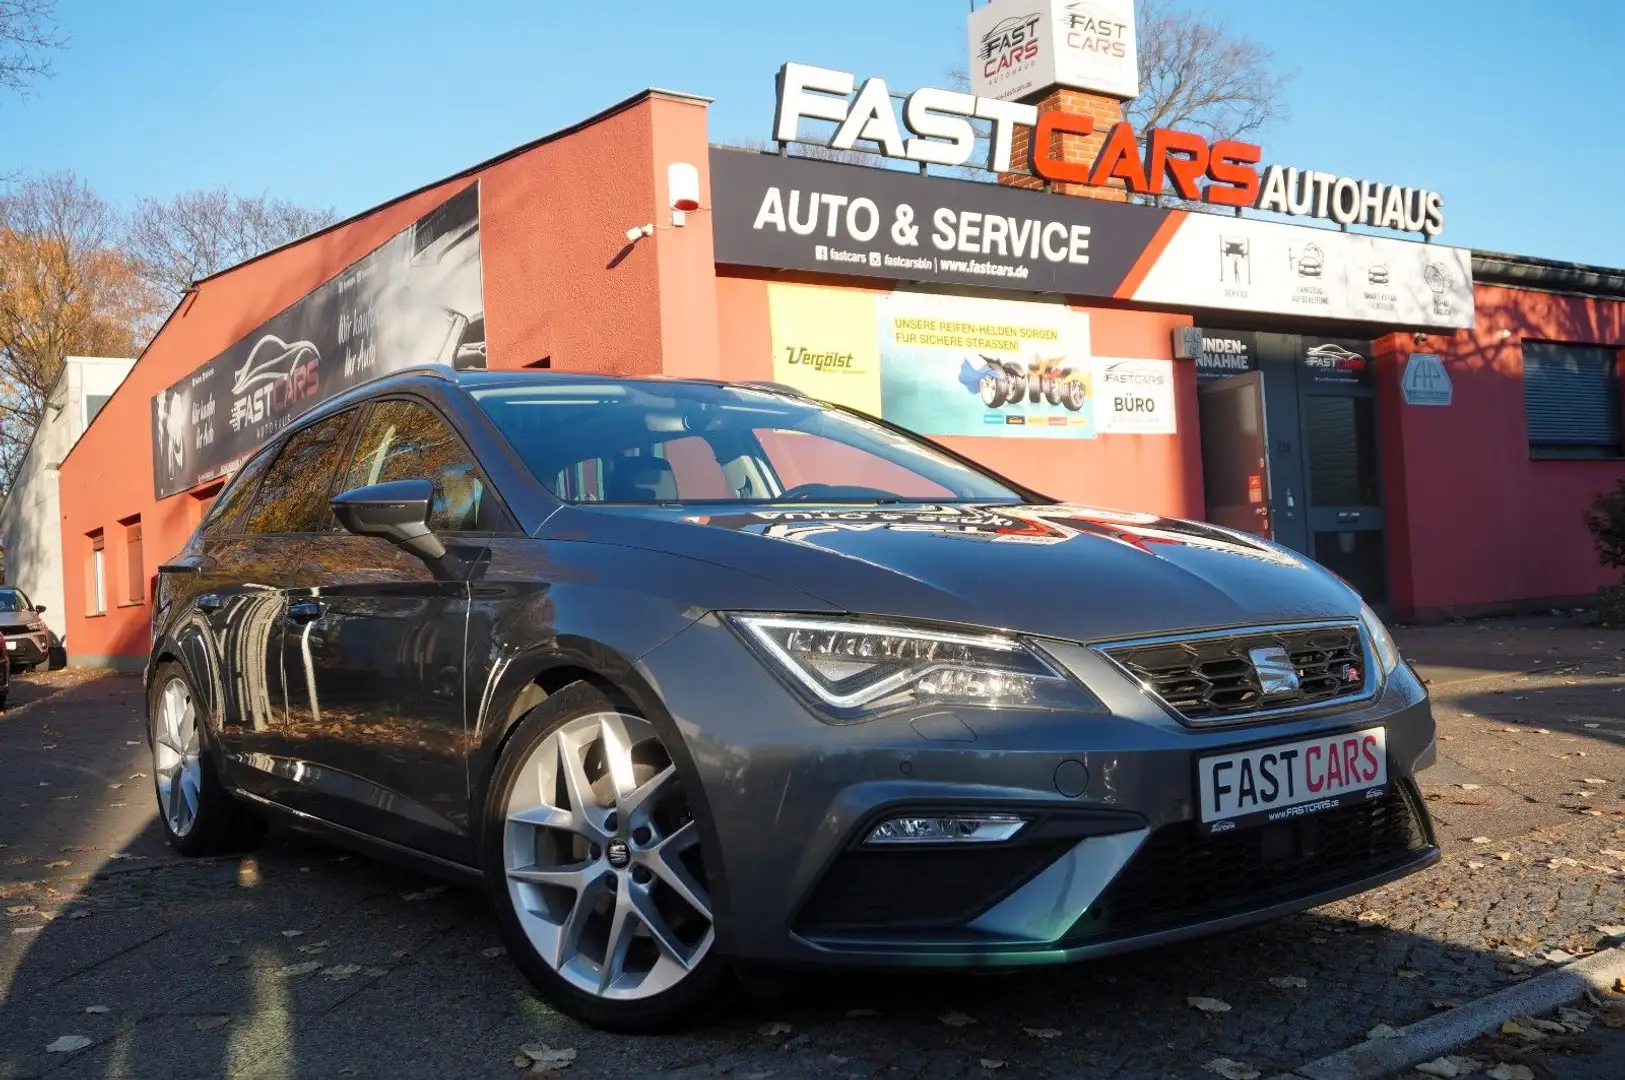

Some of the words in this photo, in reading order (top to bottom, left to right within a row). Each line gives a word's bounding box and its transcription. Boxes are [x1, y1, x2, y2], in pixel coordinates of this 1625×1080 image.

[986, 20, 1040, 57] FAST
[1068, 13, 1127, 38] FAST
[984, 37, 1040, 78] CARS
[1067, 32, 1126, 58] CARS
[1257, 165, 1443, 236] AUTOHAUS
[754, 186, 880, 242] AUTO
[891, 203, 919, 247] &
[932, 207, 1091, 264] SERVICE
[830, 247, 867, 264] fastcars
[940, 258, 1029, 279] www.fastcars.de
[894, 318, 937, 331] UNSERE
[939, 322, 1017, 337] REIFEN-HELDEN
[1019, 328, 1058, 340] SORGEN
[919, 333, 963, 347] SICHERE
[358, 337, 376, 372] Auto
[786, 346, 853, 371] Vergölst
[1114, 392, 1155, 413] BÜRO
